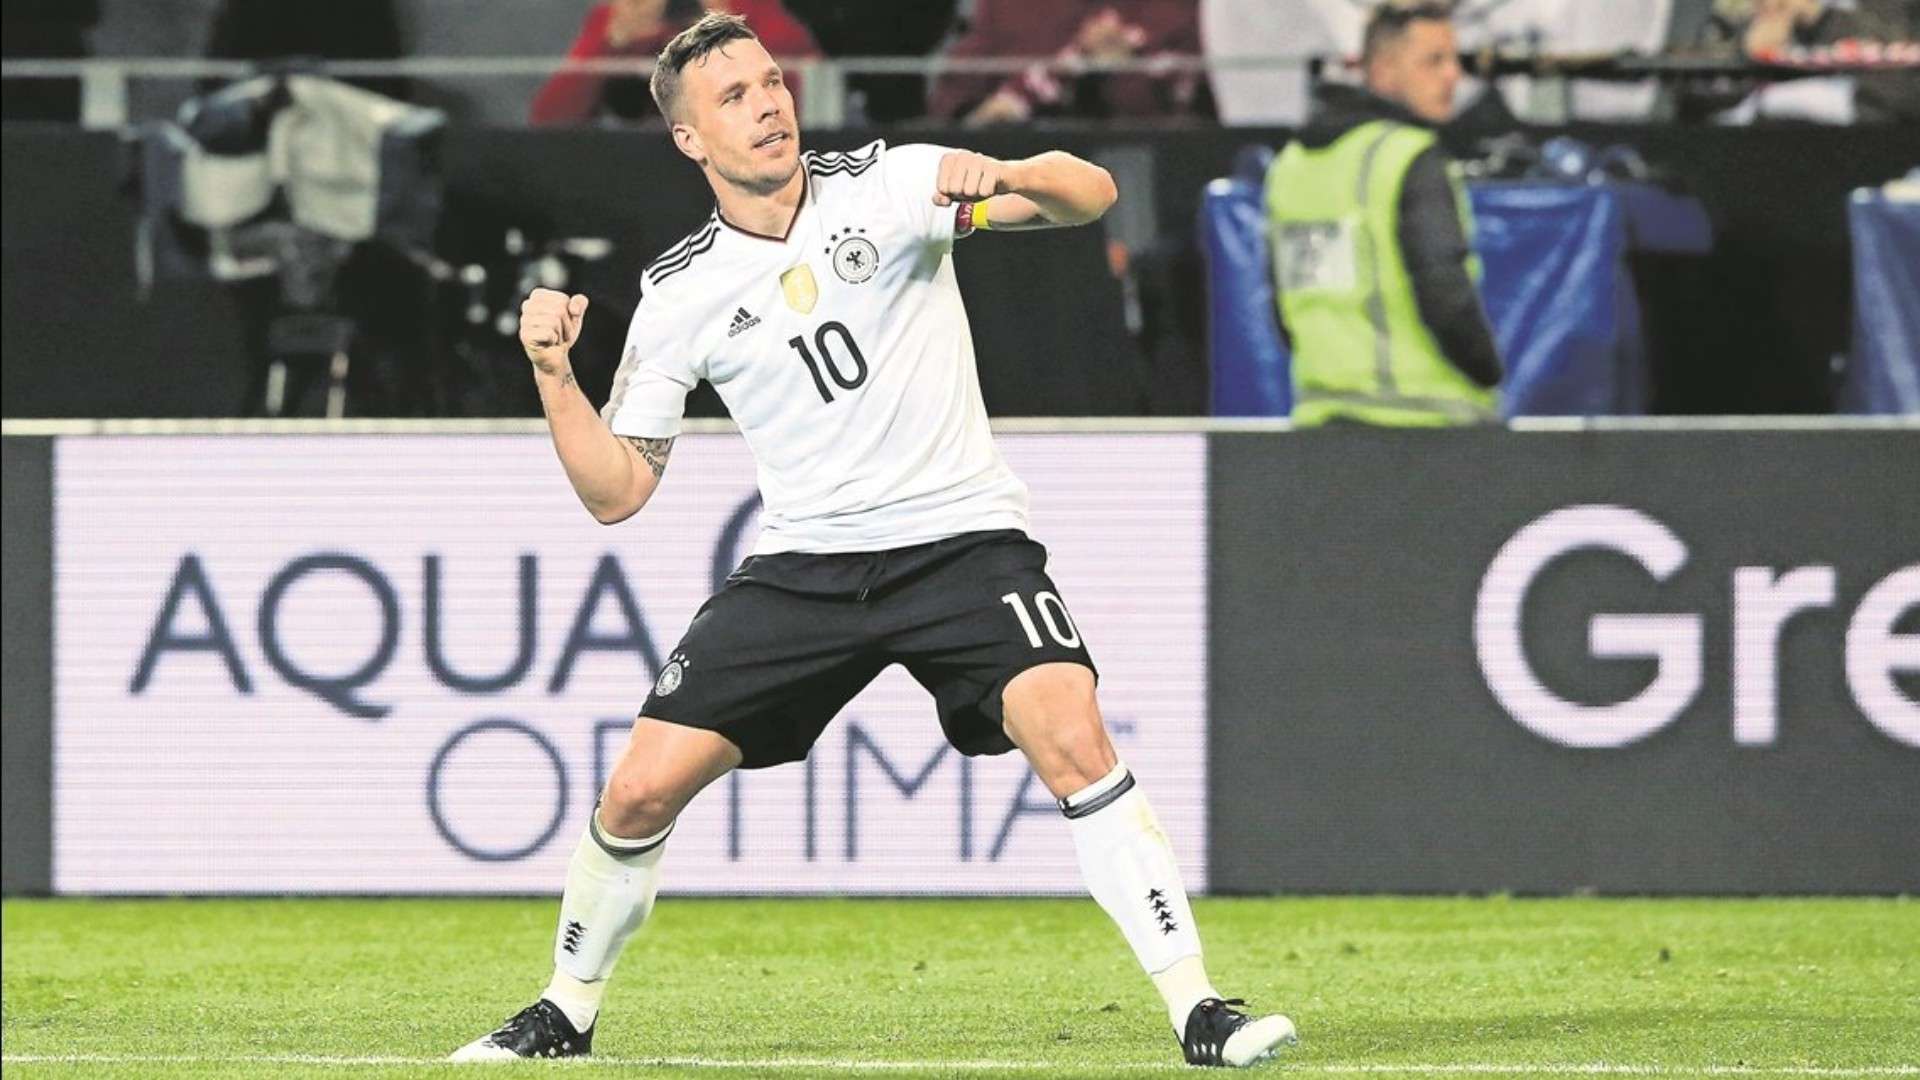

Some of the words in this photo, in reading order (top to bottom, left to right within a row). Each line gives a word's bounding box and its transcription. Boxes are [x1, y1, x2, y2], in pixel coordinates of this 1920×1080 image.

[727, 315, 761, 338] adidas
[788, 320, 867, 404] 10
[129, 552, 661, 719] AQUA
[1001, 591, 1081, 648] 10
[1473, 503, 1920, 749] Gre
